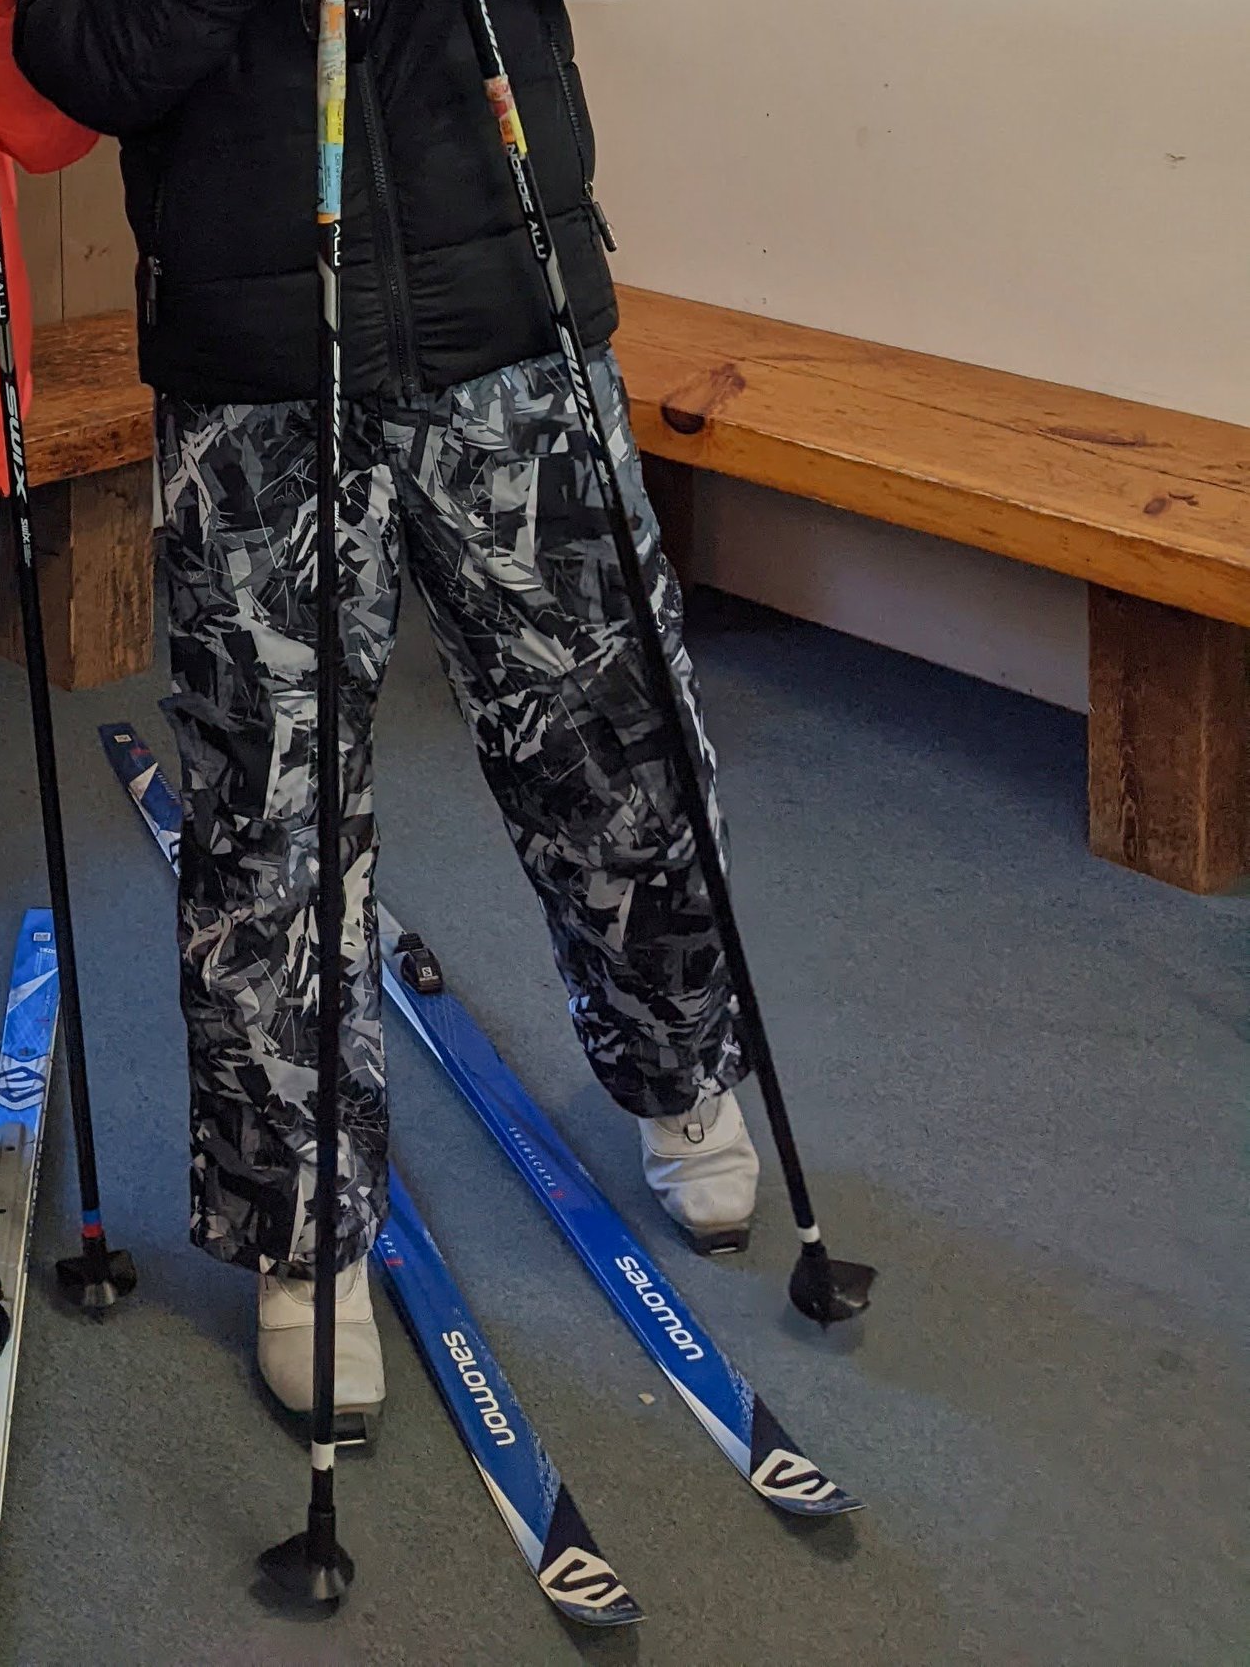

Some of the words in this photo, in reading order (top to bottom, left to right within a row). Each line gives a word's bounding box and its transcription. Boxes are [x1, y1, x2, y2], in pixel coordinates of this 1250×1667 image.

[507, 143, 534, 213] NORDIC
[528, 220, 547, 259] ALU
[5, 381, 29, 504] SWIX
[555, 321, 601, 446] SWIX
